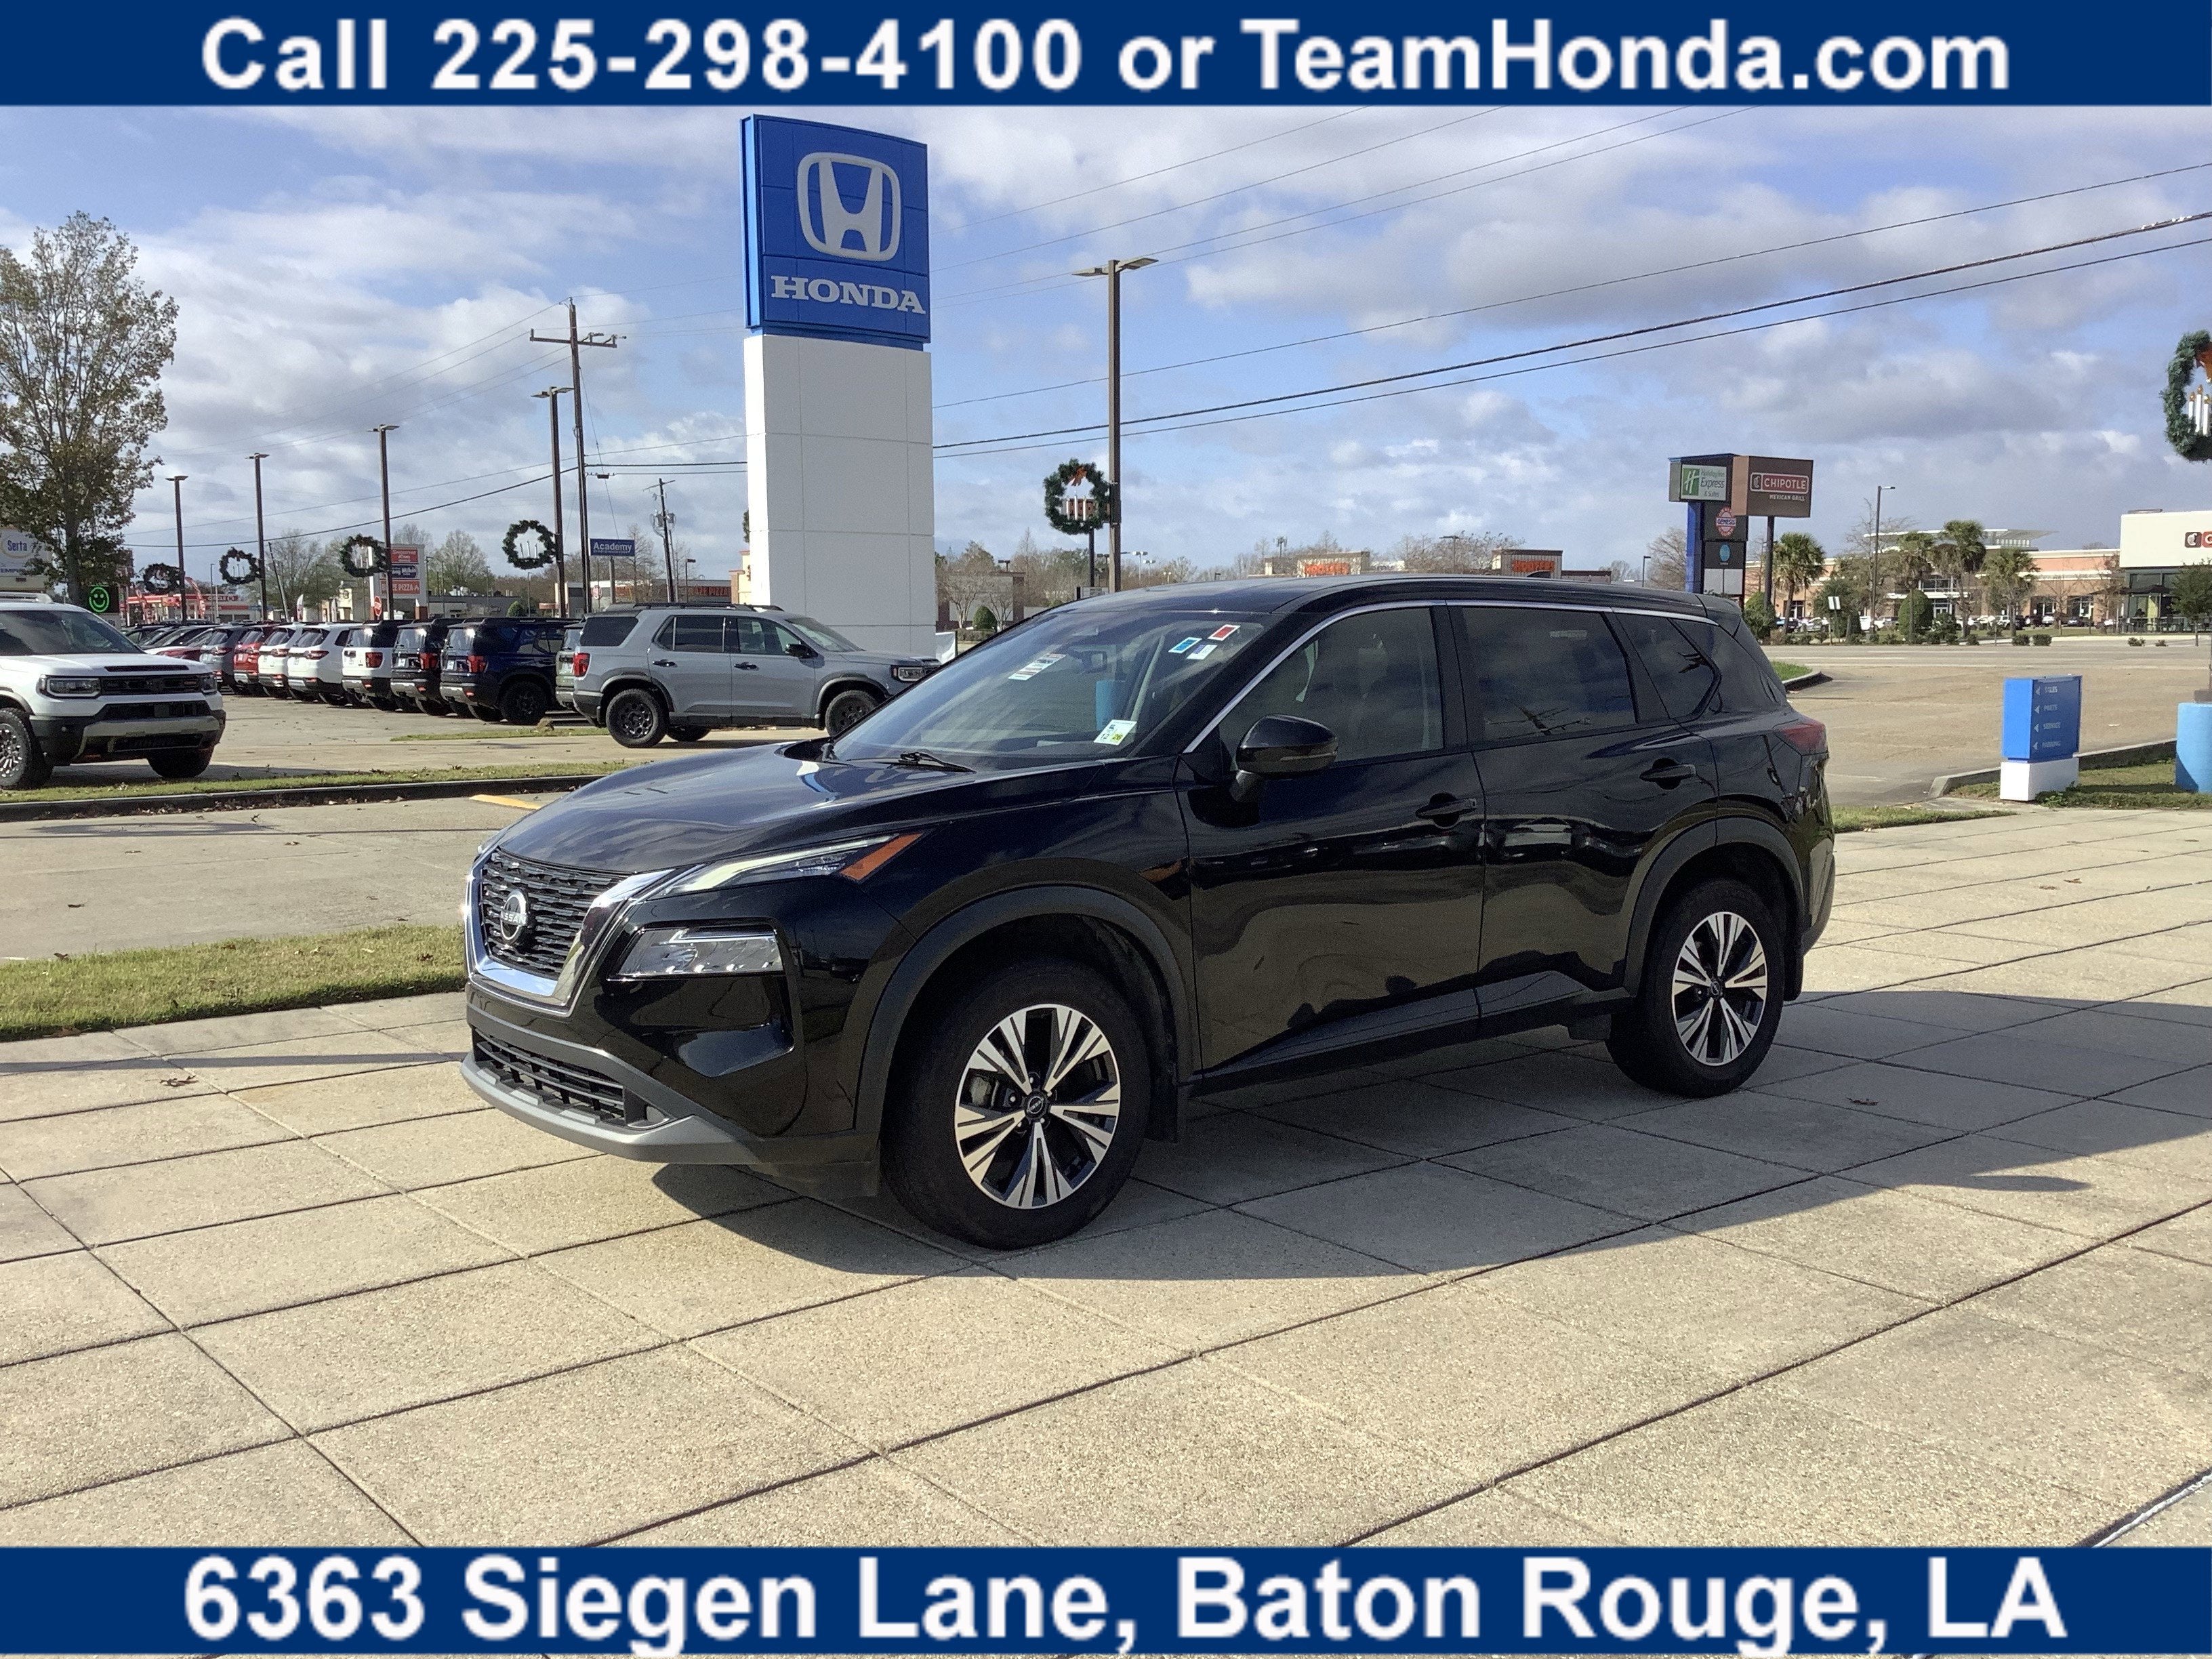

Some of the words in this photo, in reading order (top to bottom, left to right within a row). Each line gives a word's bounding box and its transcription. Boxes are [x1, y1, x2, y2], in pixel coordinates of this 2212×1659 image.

[771, 274, 926, 314] HONDA
[1764, 478, 1807, 489] CHIPOTLE
[7, 540, 28, 552] Serta
[593, 541, 632, 553] Academy
